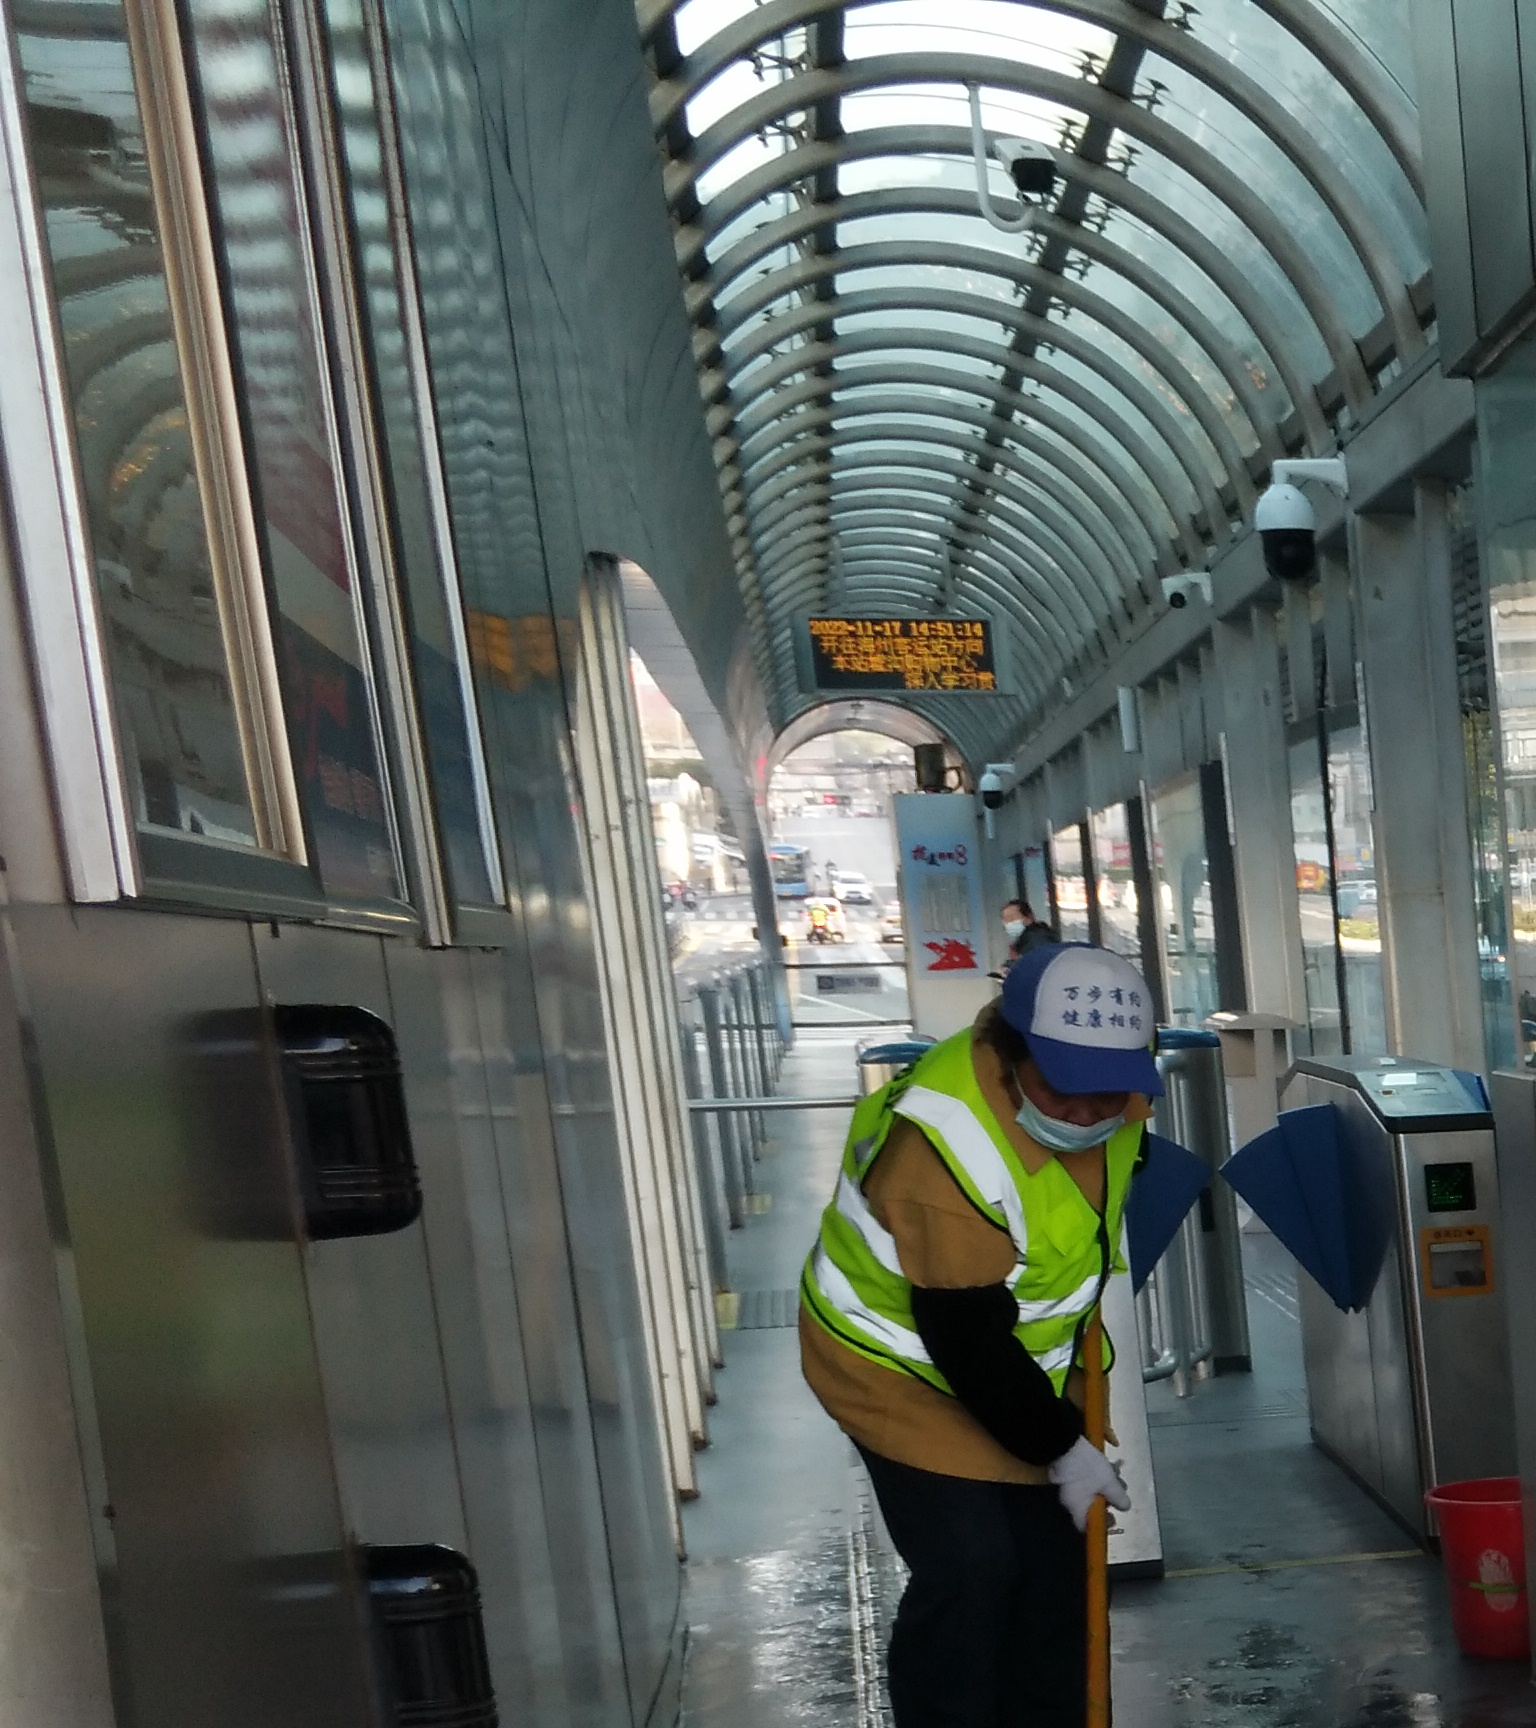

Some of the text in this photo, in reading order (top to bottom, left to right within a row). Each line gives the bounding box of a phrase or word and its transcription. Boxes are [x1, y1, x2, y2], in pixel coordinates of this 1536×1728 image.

[809, 620, 984, 637] 2022-11-17 14:51:14
[1063, 985, 1142, 1008] 万步有约
[1062, 1008, 1143, 1031] 健康相约
